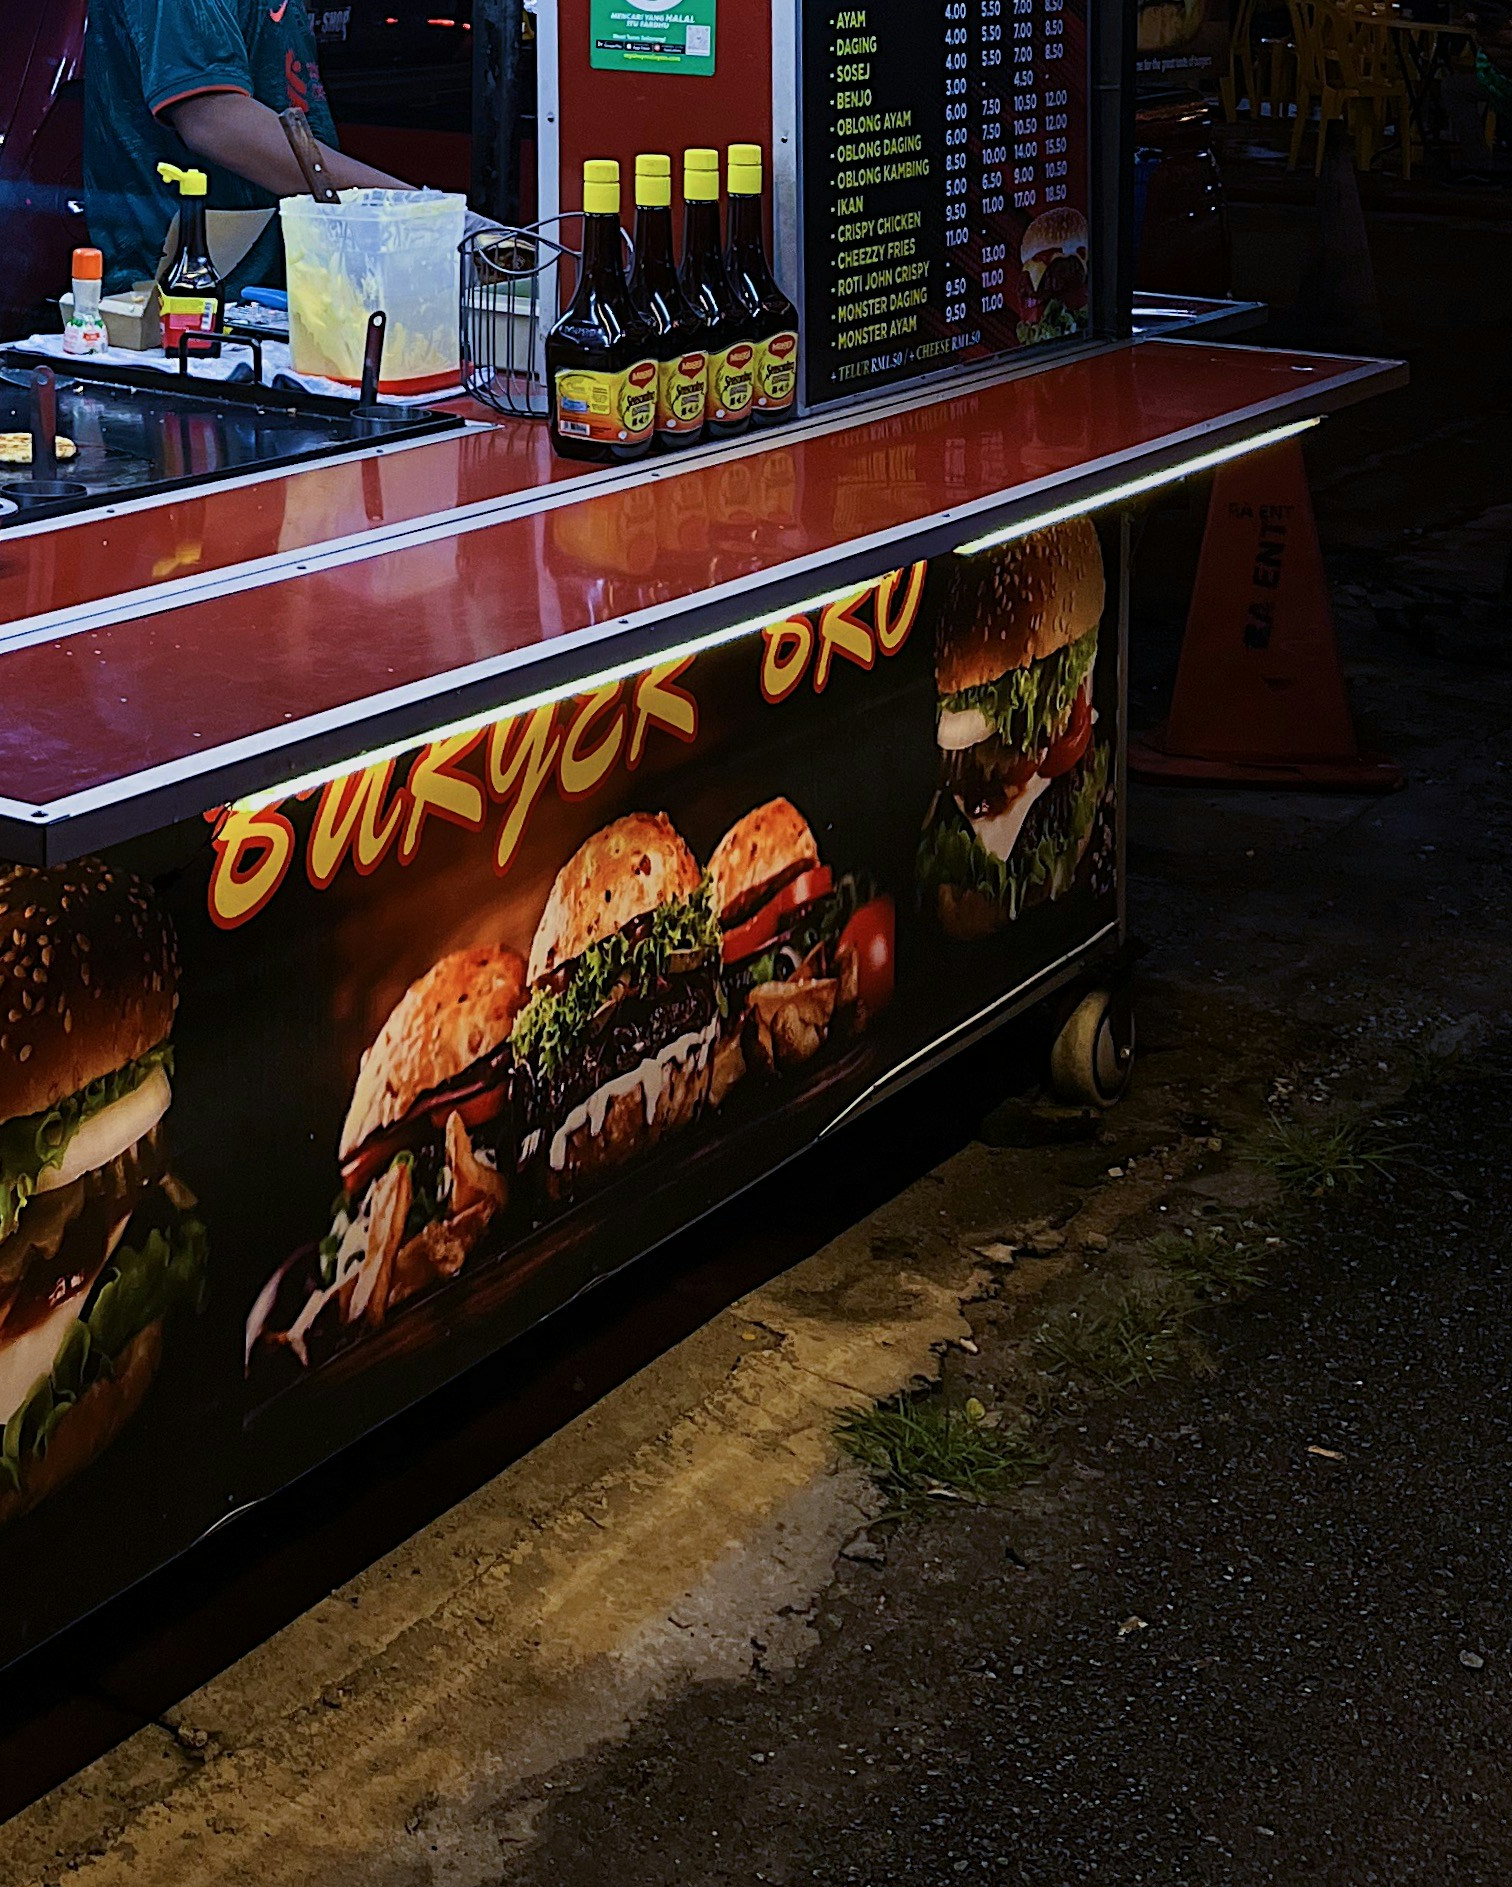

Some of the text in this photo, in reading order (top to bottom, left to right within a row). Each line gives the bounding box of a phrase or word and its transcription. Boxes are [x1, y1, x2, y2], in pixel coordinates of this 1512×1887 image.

[836, 10, 866, 29] AYAM
[945, 2, 967, 20] 4.00
[981, 0, 1001, 17] 5.50
[836, 19, 1064, 56] DAGING 4.00 5.50 7.00 8.50
[836, 42, 1064, 83] SOSEJ 4.00 5.50 7.00 8.50
[836, 69, 1034, 110] BENJO 3.00 4.50
[836, 89, 1067, 136] OBLONG AYAM 6.00 7.50 10.50 12.00
[836, 113, 1068, 163] OBLONG DAGING 6.00 7.50 10.50 12.00
[836, 136, 1067, 190] OBLONG KAMBING 8.50 10.00 14.00 15.50
[837, 160, 1068, 217] IKAN 5.00 6.50 9.00 10.50
[837, 184, 1067, 243] CRISPY CHICKEN 9.50 11.00 17.00 18.50
[837, 226, 969, 270] CHEEZZY FRIES 11.00
[837, 243, 1006, 297] ROTI JOHN CRISPY 13.00
[838, 268, 1004, 324] MONSTER DAGING 9.50 11.00
[838, 292, 1004, 351] MONSTER AYAM 9.50 11.00
[838, 359, 870, 382] TELUR
[916, 338, 951, 361] CHEESE
